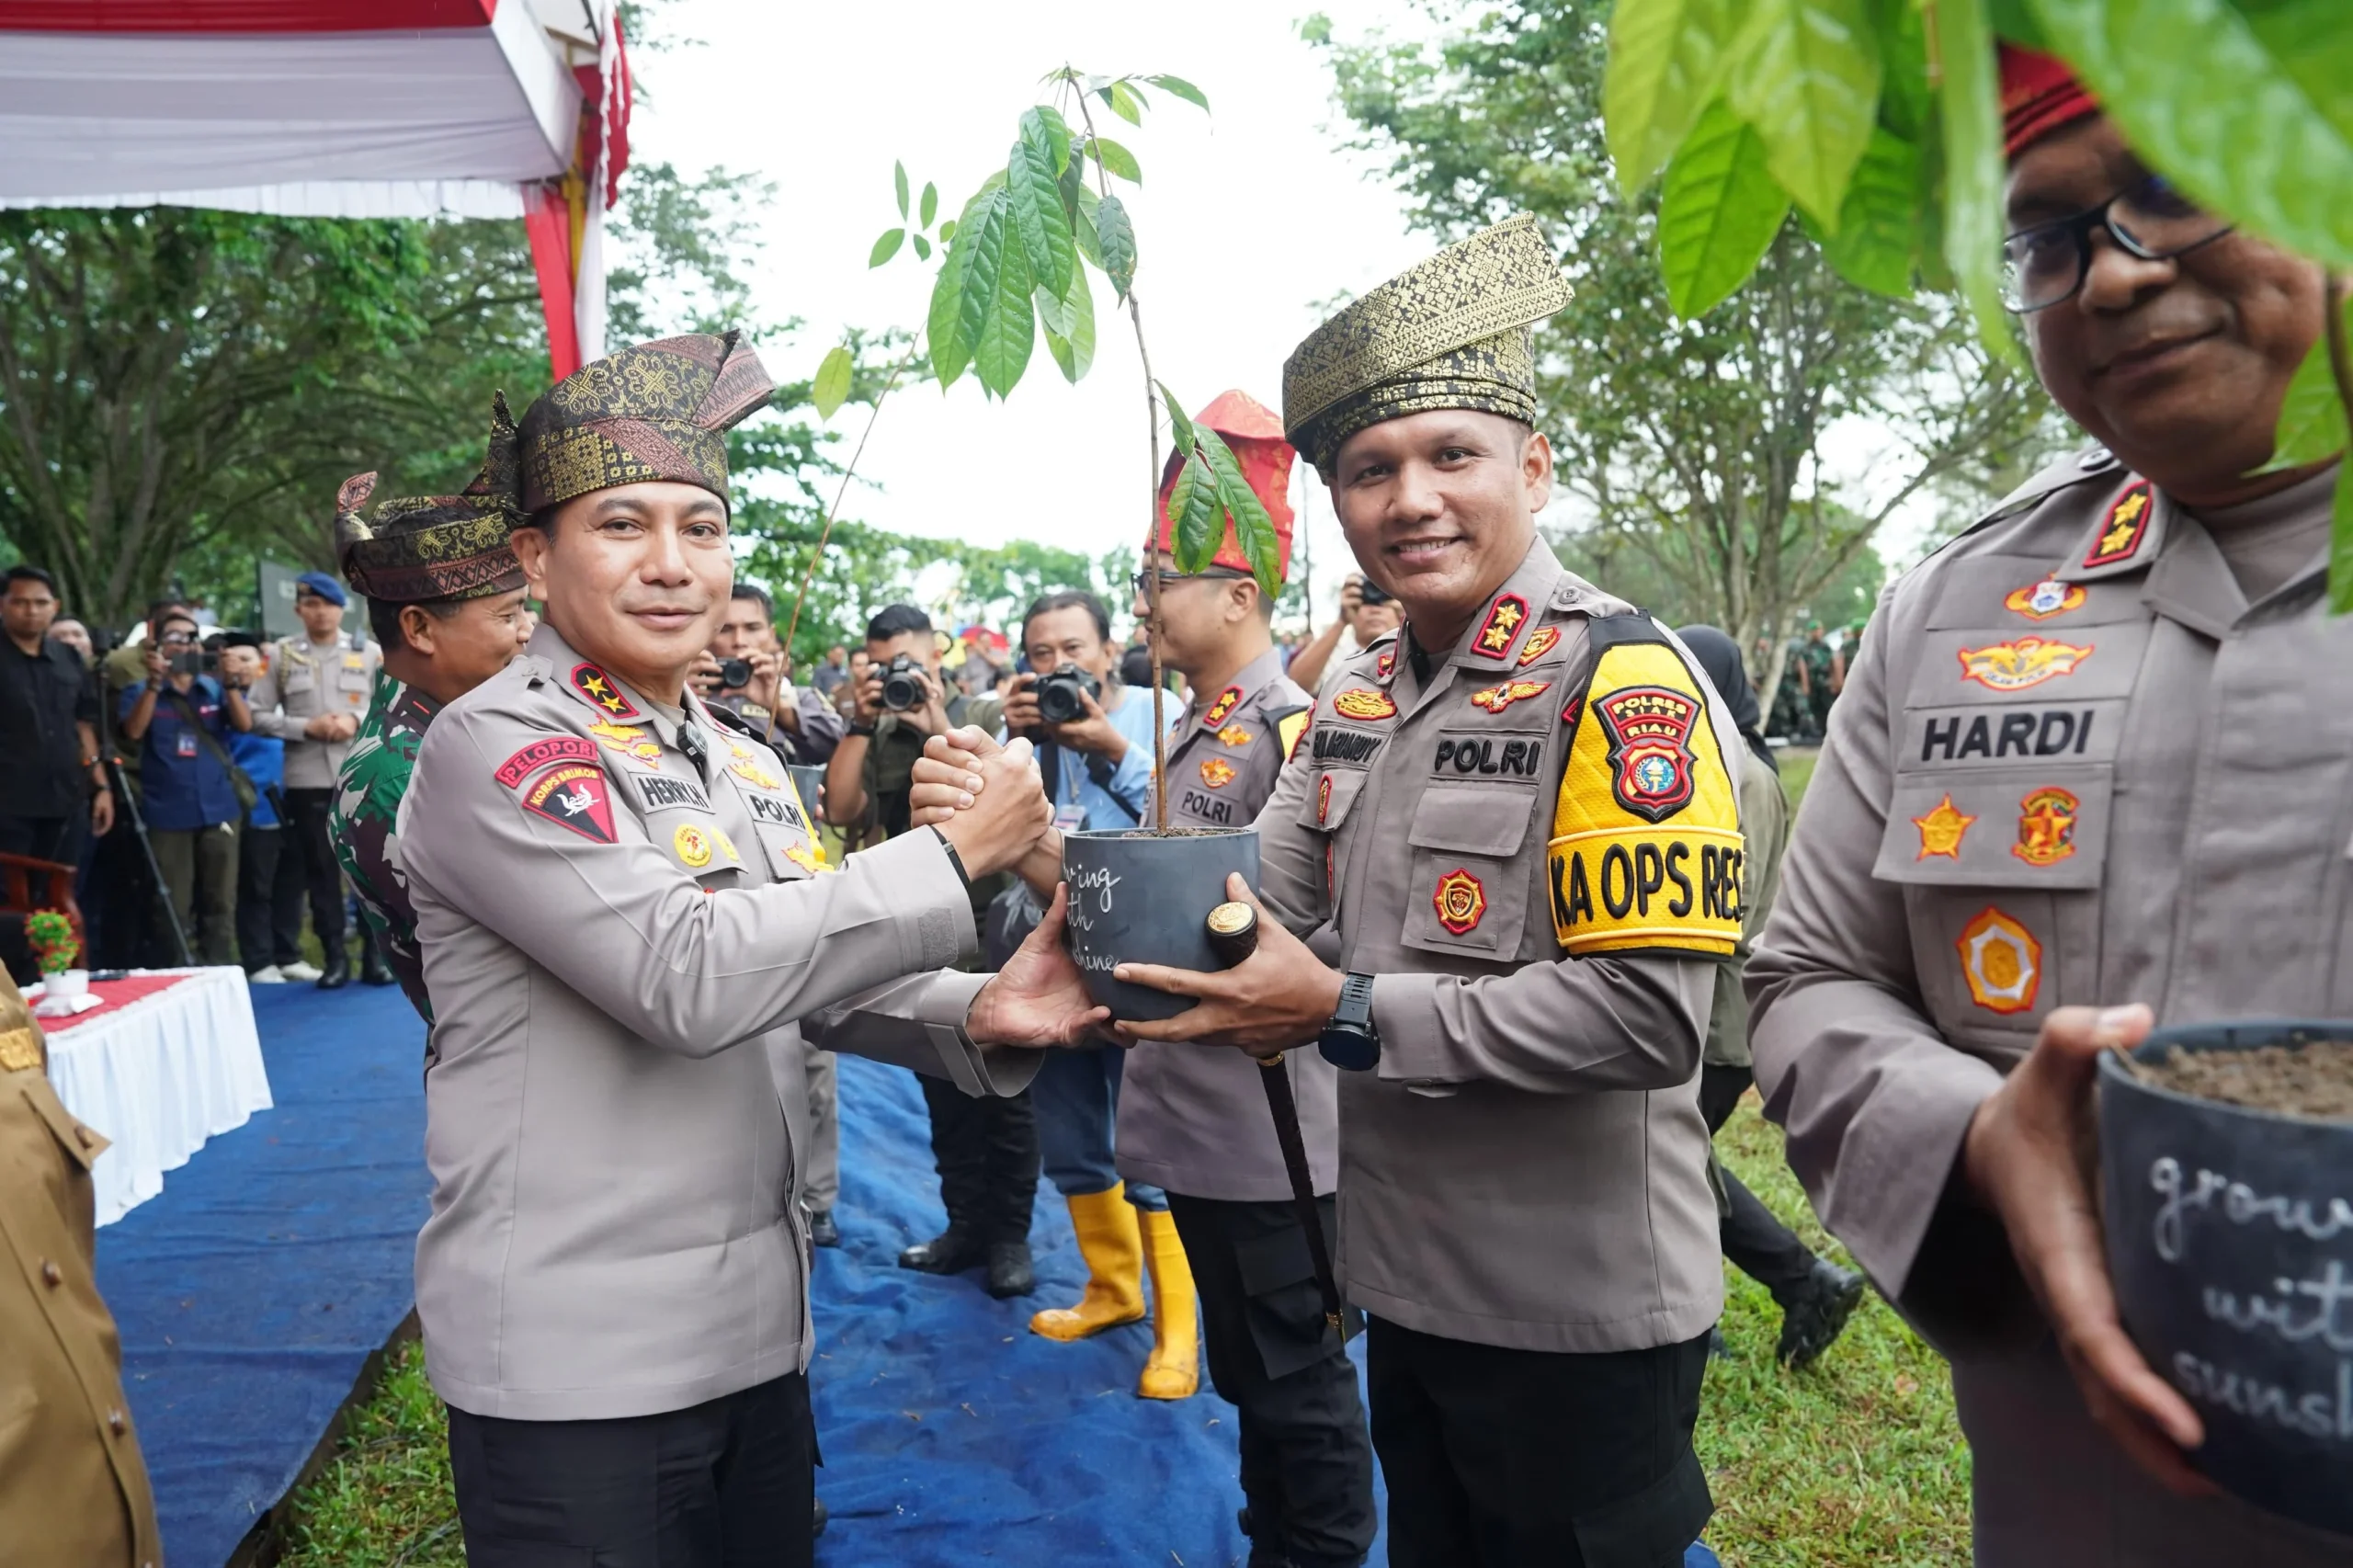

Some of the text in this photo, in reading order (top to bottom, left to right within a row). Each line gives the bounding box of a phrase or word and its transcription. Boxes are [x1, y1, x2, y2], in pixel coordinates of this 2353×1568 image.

[1611, 695, 1687, 715] POLRES
[1624, 705, 1677, 718] SIAK
[1627, 723, 1677, 737] RIAU
[1920, 710, 2094, 761] HARDI
[501, 741, 592, 781] PELOPOR
[1434, 738, 1541, 775] POLRI
[529, 767, 598, 806] KORPS BRIMOB
[749, 794, 806, 831] POLRI
[1182, 790, 1232, 824] POLRI
[1551, 841, 1742, 928] KA OPS RES
